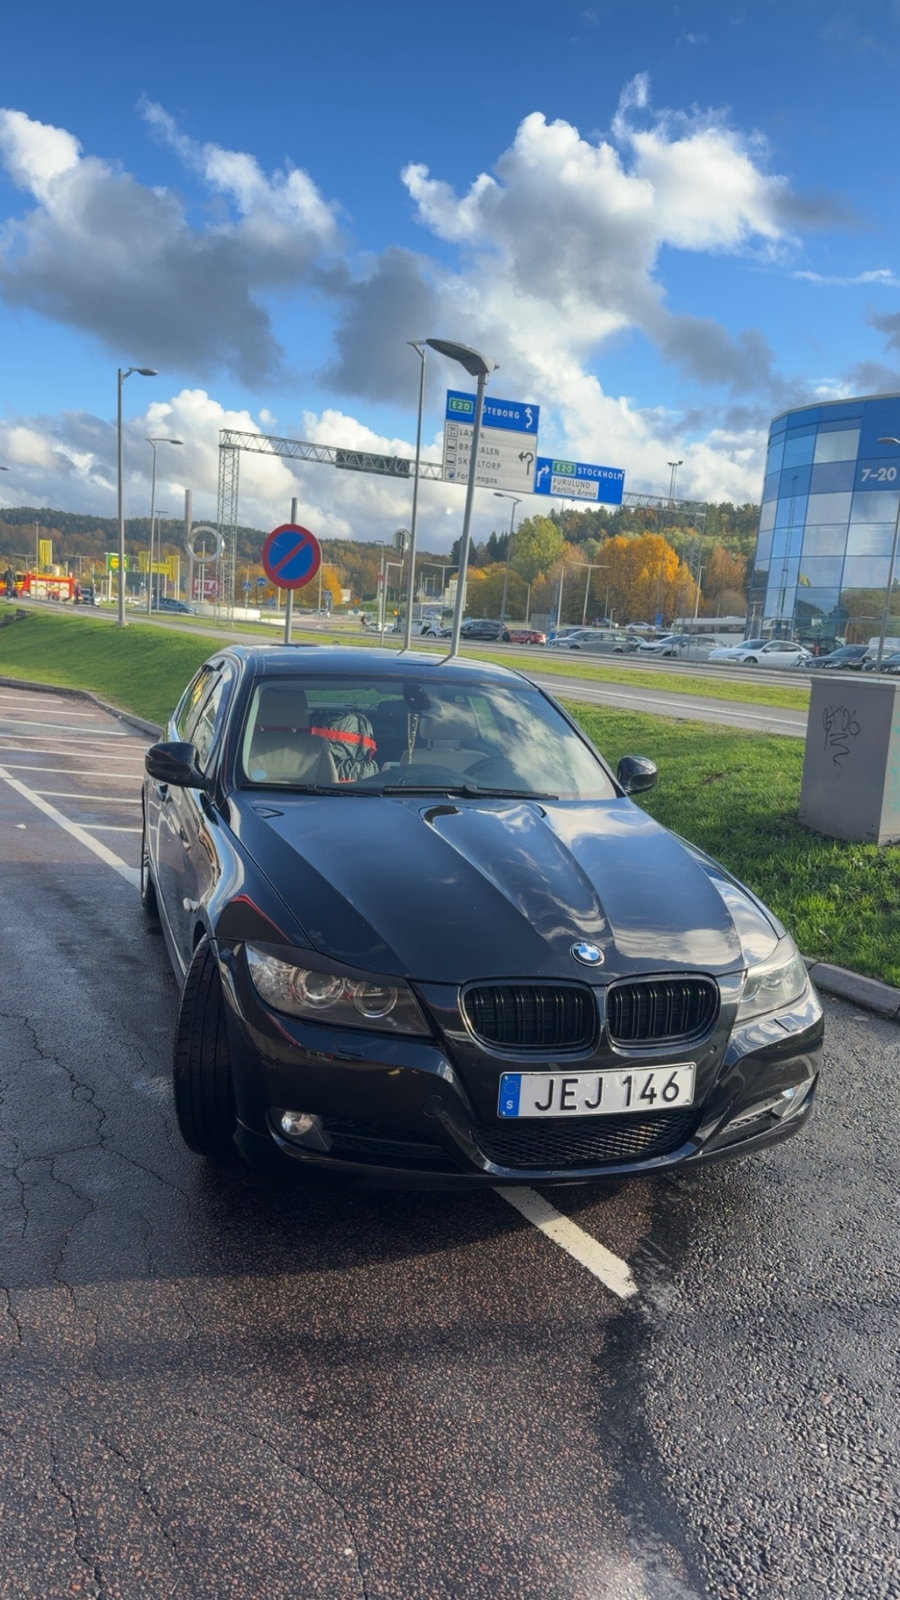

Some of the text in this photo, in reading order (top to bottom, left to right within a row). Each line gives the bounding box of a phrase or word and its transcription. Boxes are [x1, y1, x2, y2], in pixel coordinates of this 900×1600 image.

[452, 401, 520, 420] E20 ÖTEBORG
[459, 428, 485, 439] LAXN
[458, 443, 500, 456] BRALEN
[457, 457, 502, 470] SKLTORP
[456, 471, 498, 484] Fornsgas
[556, 464, 623, 480] E20 STOCKHOLM
[553, 477, 591, 489] FURULUND
[552, 486, 597, 498] Partille Arena
[534, 1071, 680, 1111] JEJ 146
[505, 1100, 514, 1109] S
